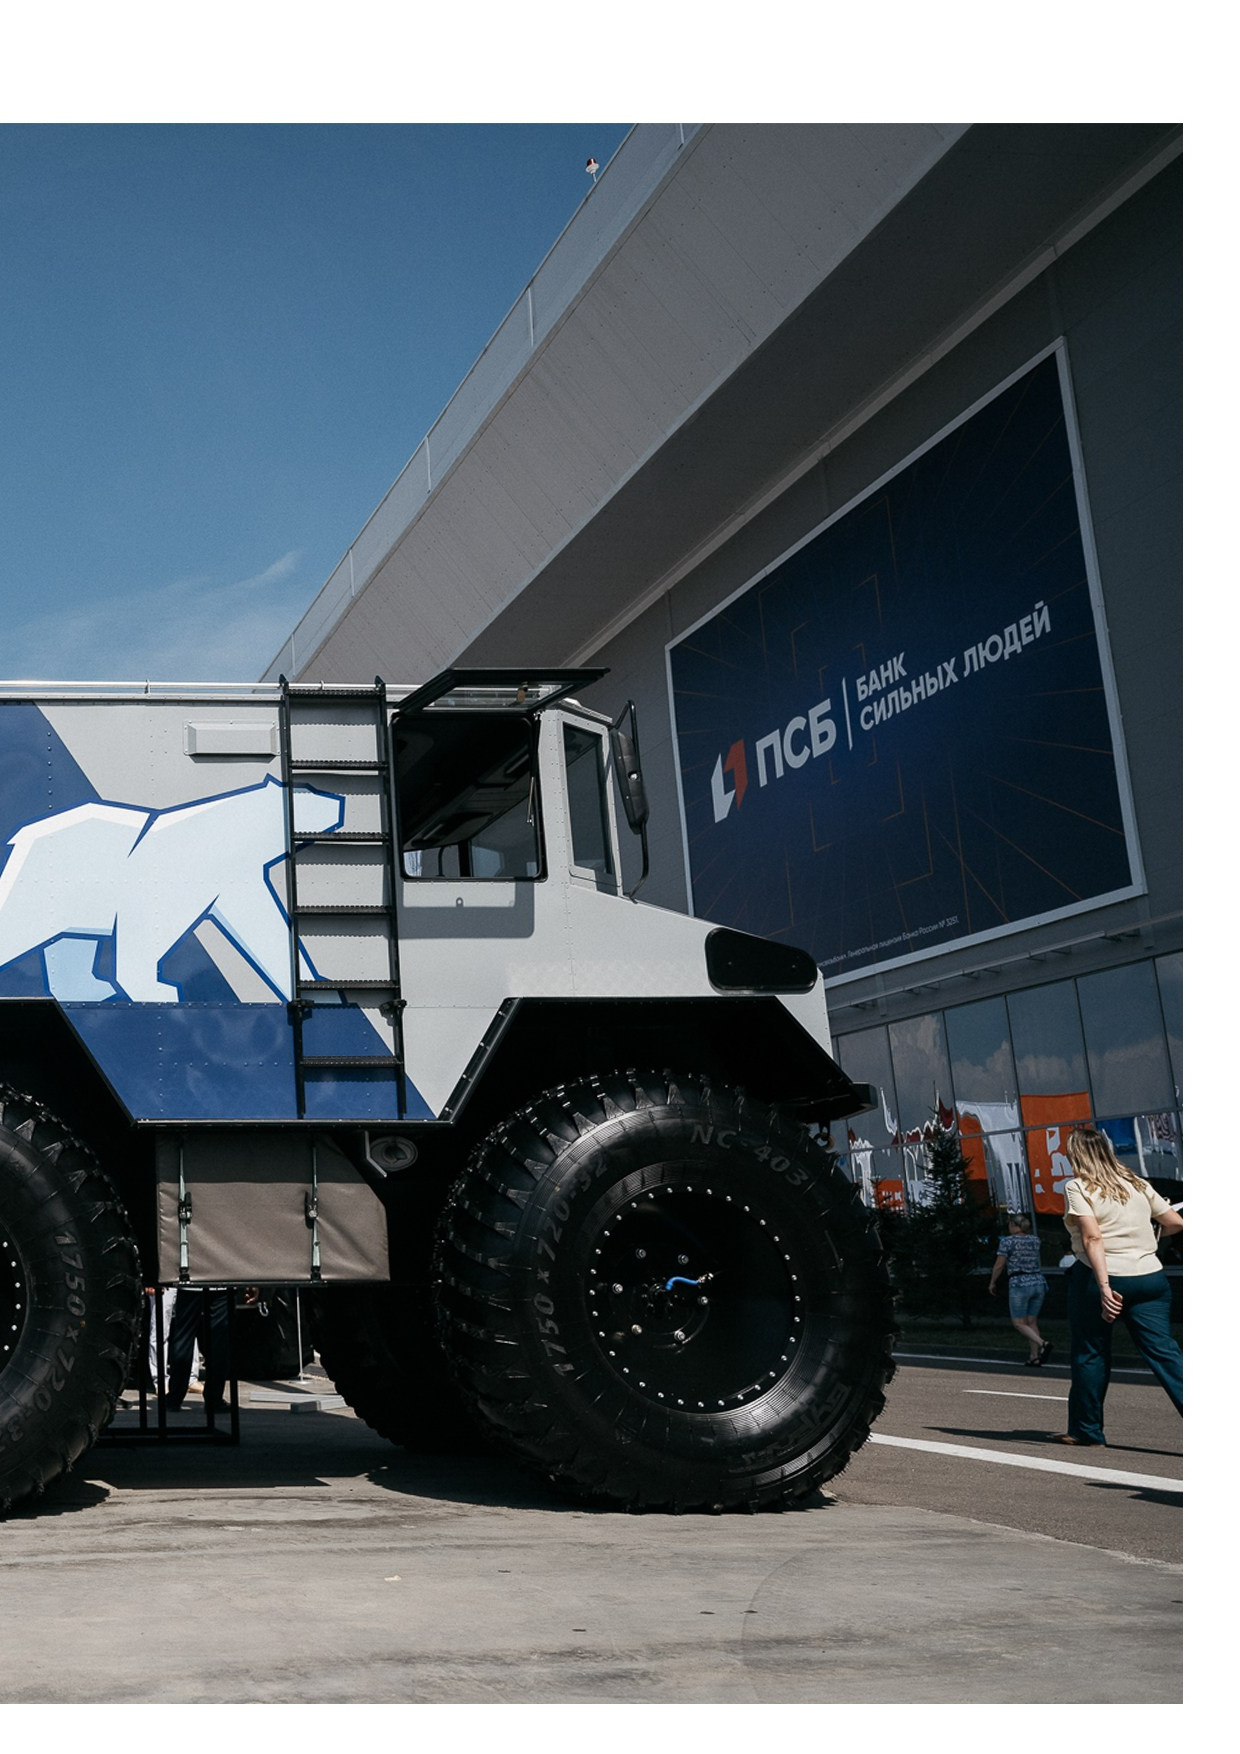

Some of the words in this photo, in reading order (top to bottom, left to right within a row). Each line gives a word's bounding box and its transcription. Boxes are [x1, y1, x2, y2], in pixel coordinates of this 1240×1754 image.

[856, 651, 907, 701] БАНК
[860, 657, 958, 731] СИЛЬНЫХ
[963, 600, 1051, 678] ЛЮДЕЙ
[755, 698, 837, 788] ПСБ
[690, 1123, 809, 1187] NC-403
[54, 1230, 86, 1317] 1750
